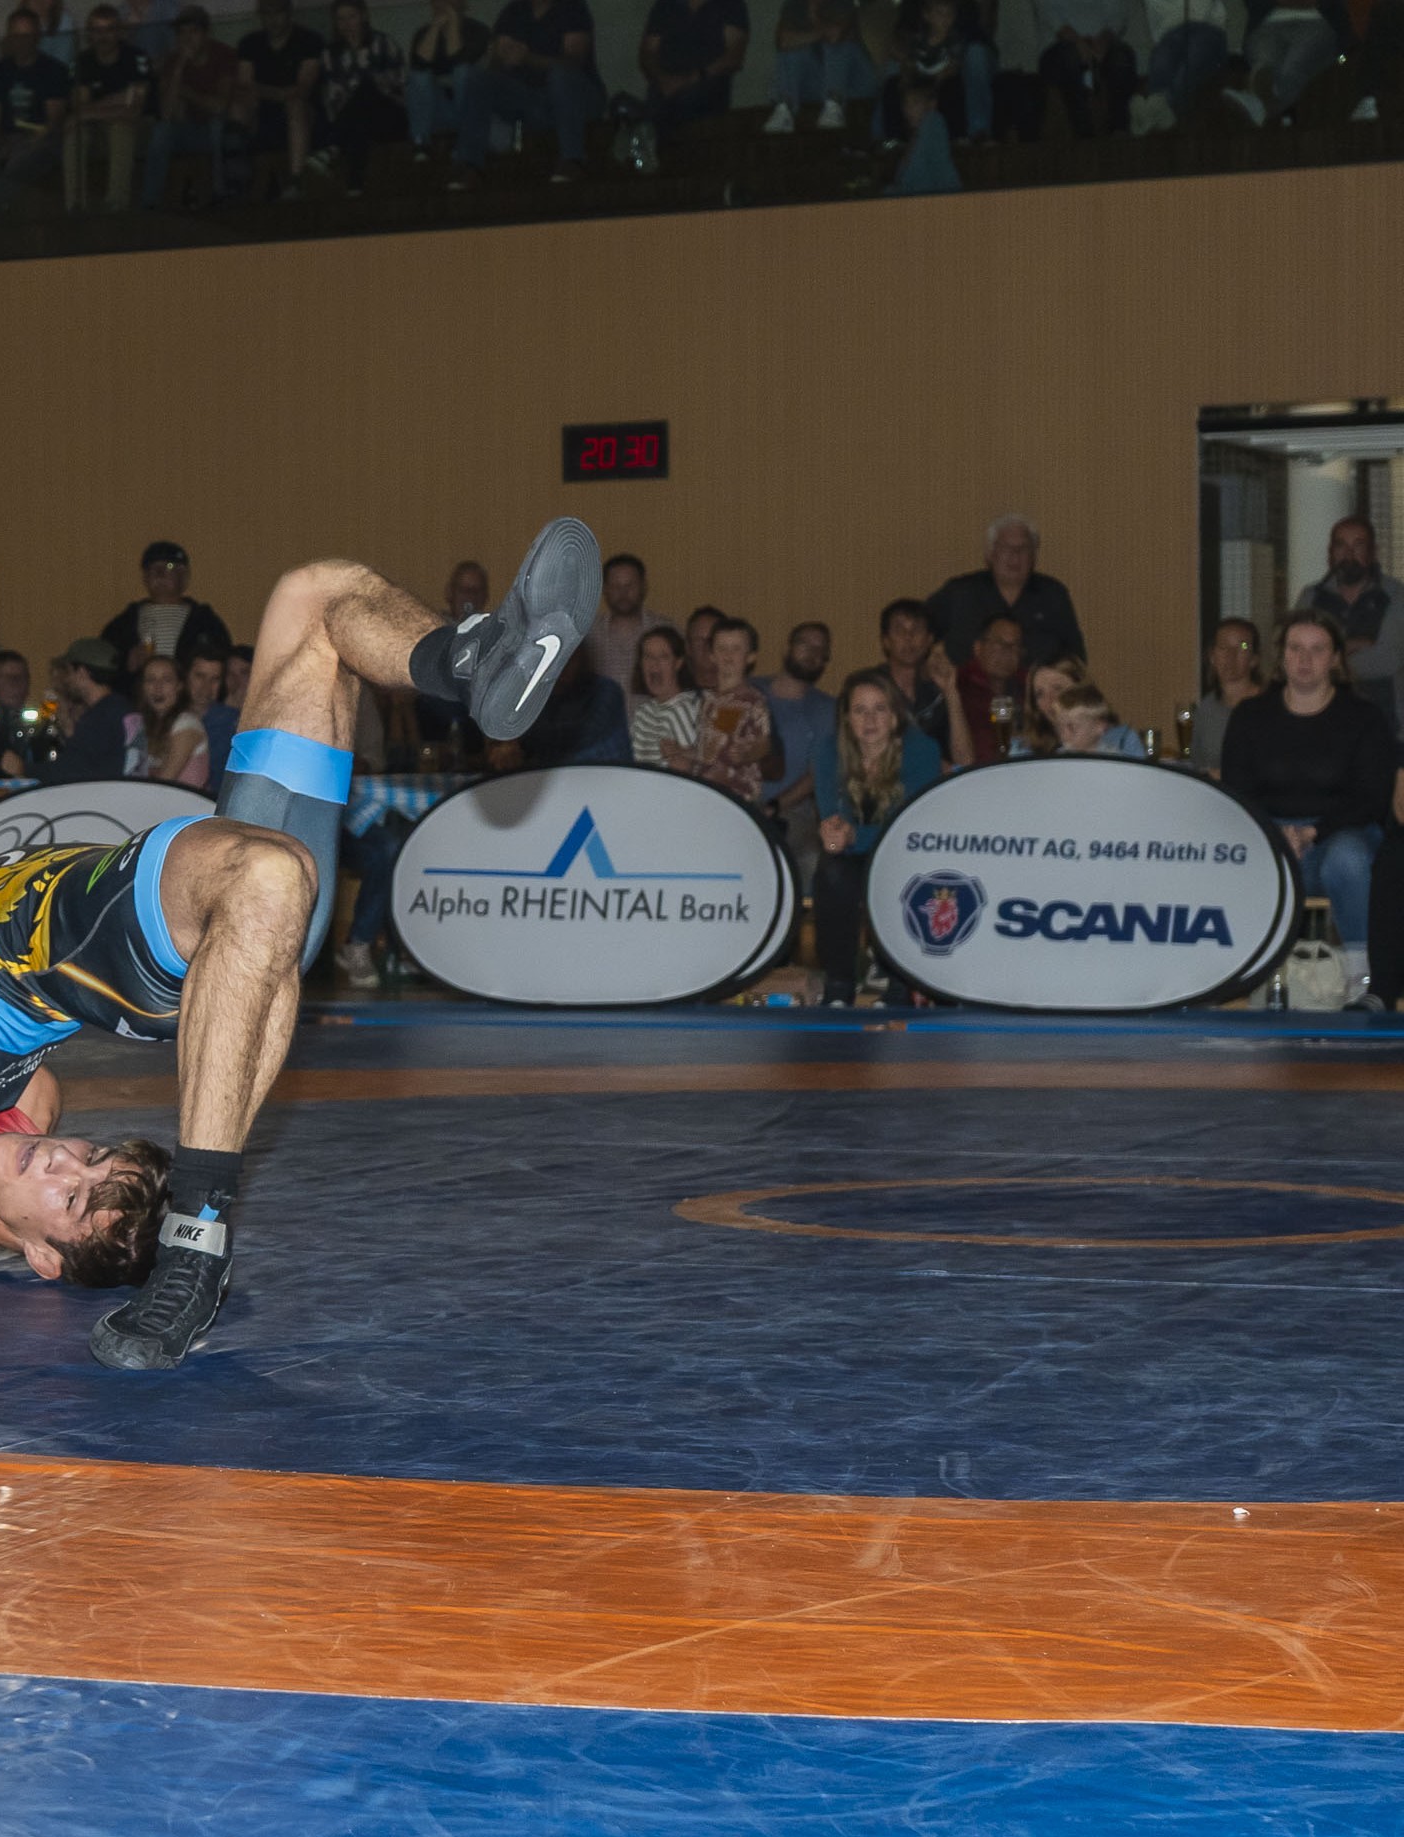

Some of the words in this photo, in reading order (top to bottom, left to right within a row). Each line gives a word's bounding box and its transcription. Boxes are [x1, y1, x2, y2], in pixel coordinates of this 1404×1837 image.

[906, 832, 1039, 857] SCHUMONT
[1043, 839, 1081, 861] AG,
[1089, 840, 1139, 860] 9464
[1147, 840, 1206, 862] Rüthi
[1213, 843, 1247, 864] SG
[408, 887, 489, 923] Alpha
[500, 885, 668, 923] RHEINTAL
[679, 893, 749, 923] Bank
[994, 897, 1234, 948] SCANIA
[173, 1223, 205, 1242] NIKE
